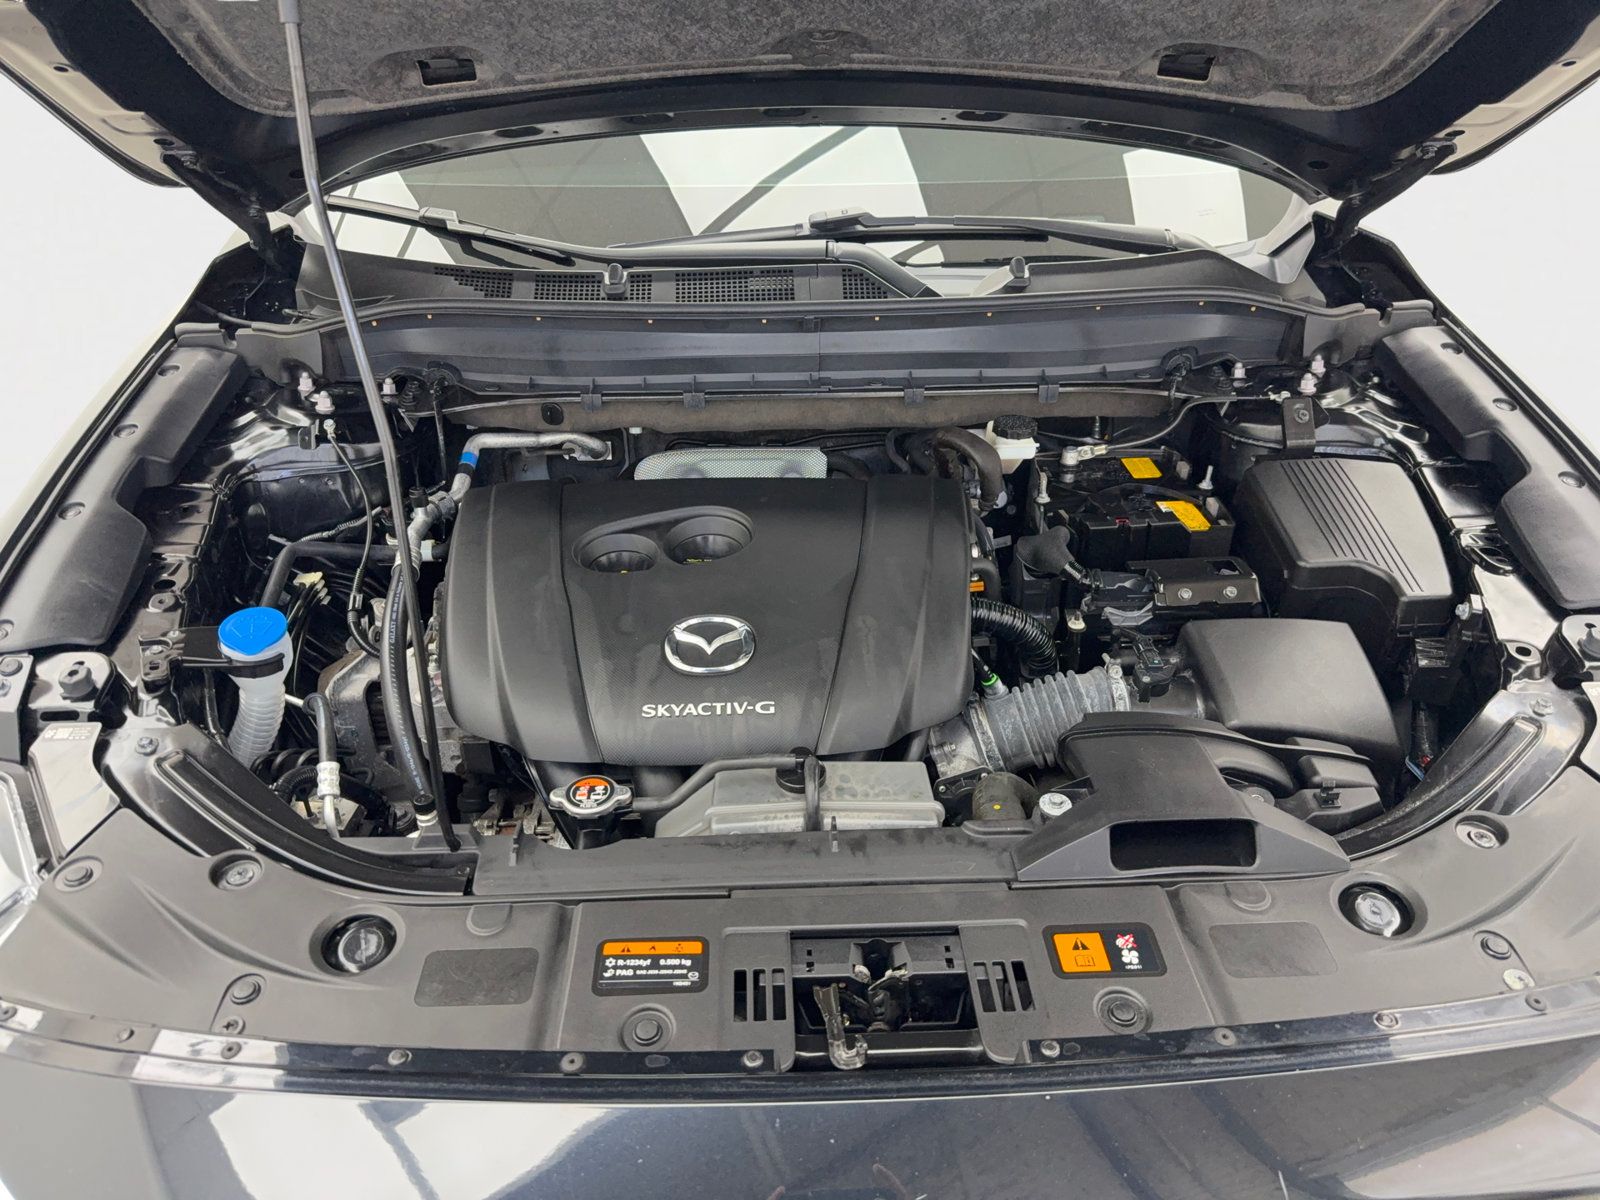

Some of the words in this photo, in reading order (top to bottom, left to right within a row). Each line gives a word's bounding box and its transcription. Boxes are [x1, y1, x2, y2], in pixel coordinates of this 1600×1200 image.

[641, 701, 776, 718] SKYACTIV-G
[617, 959, 651, 967] R-1234yf
[681, 958, 692, 967] kg
